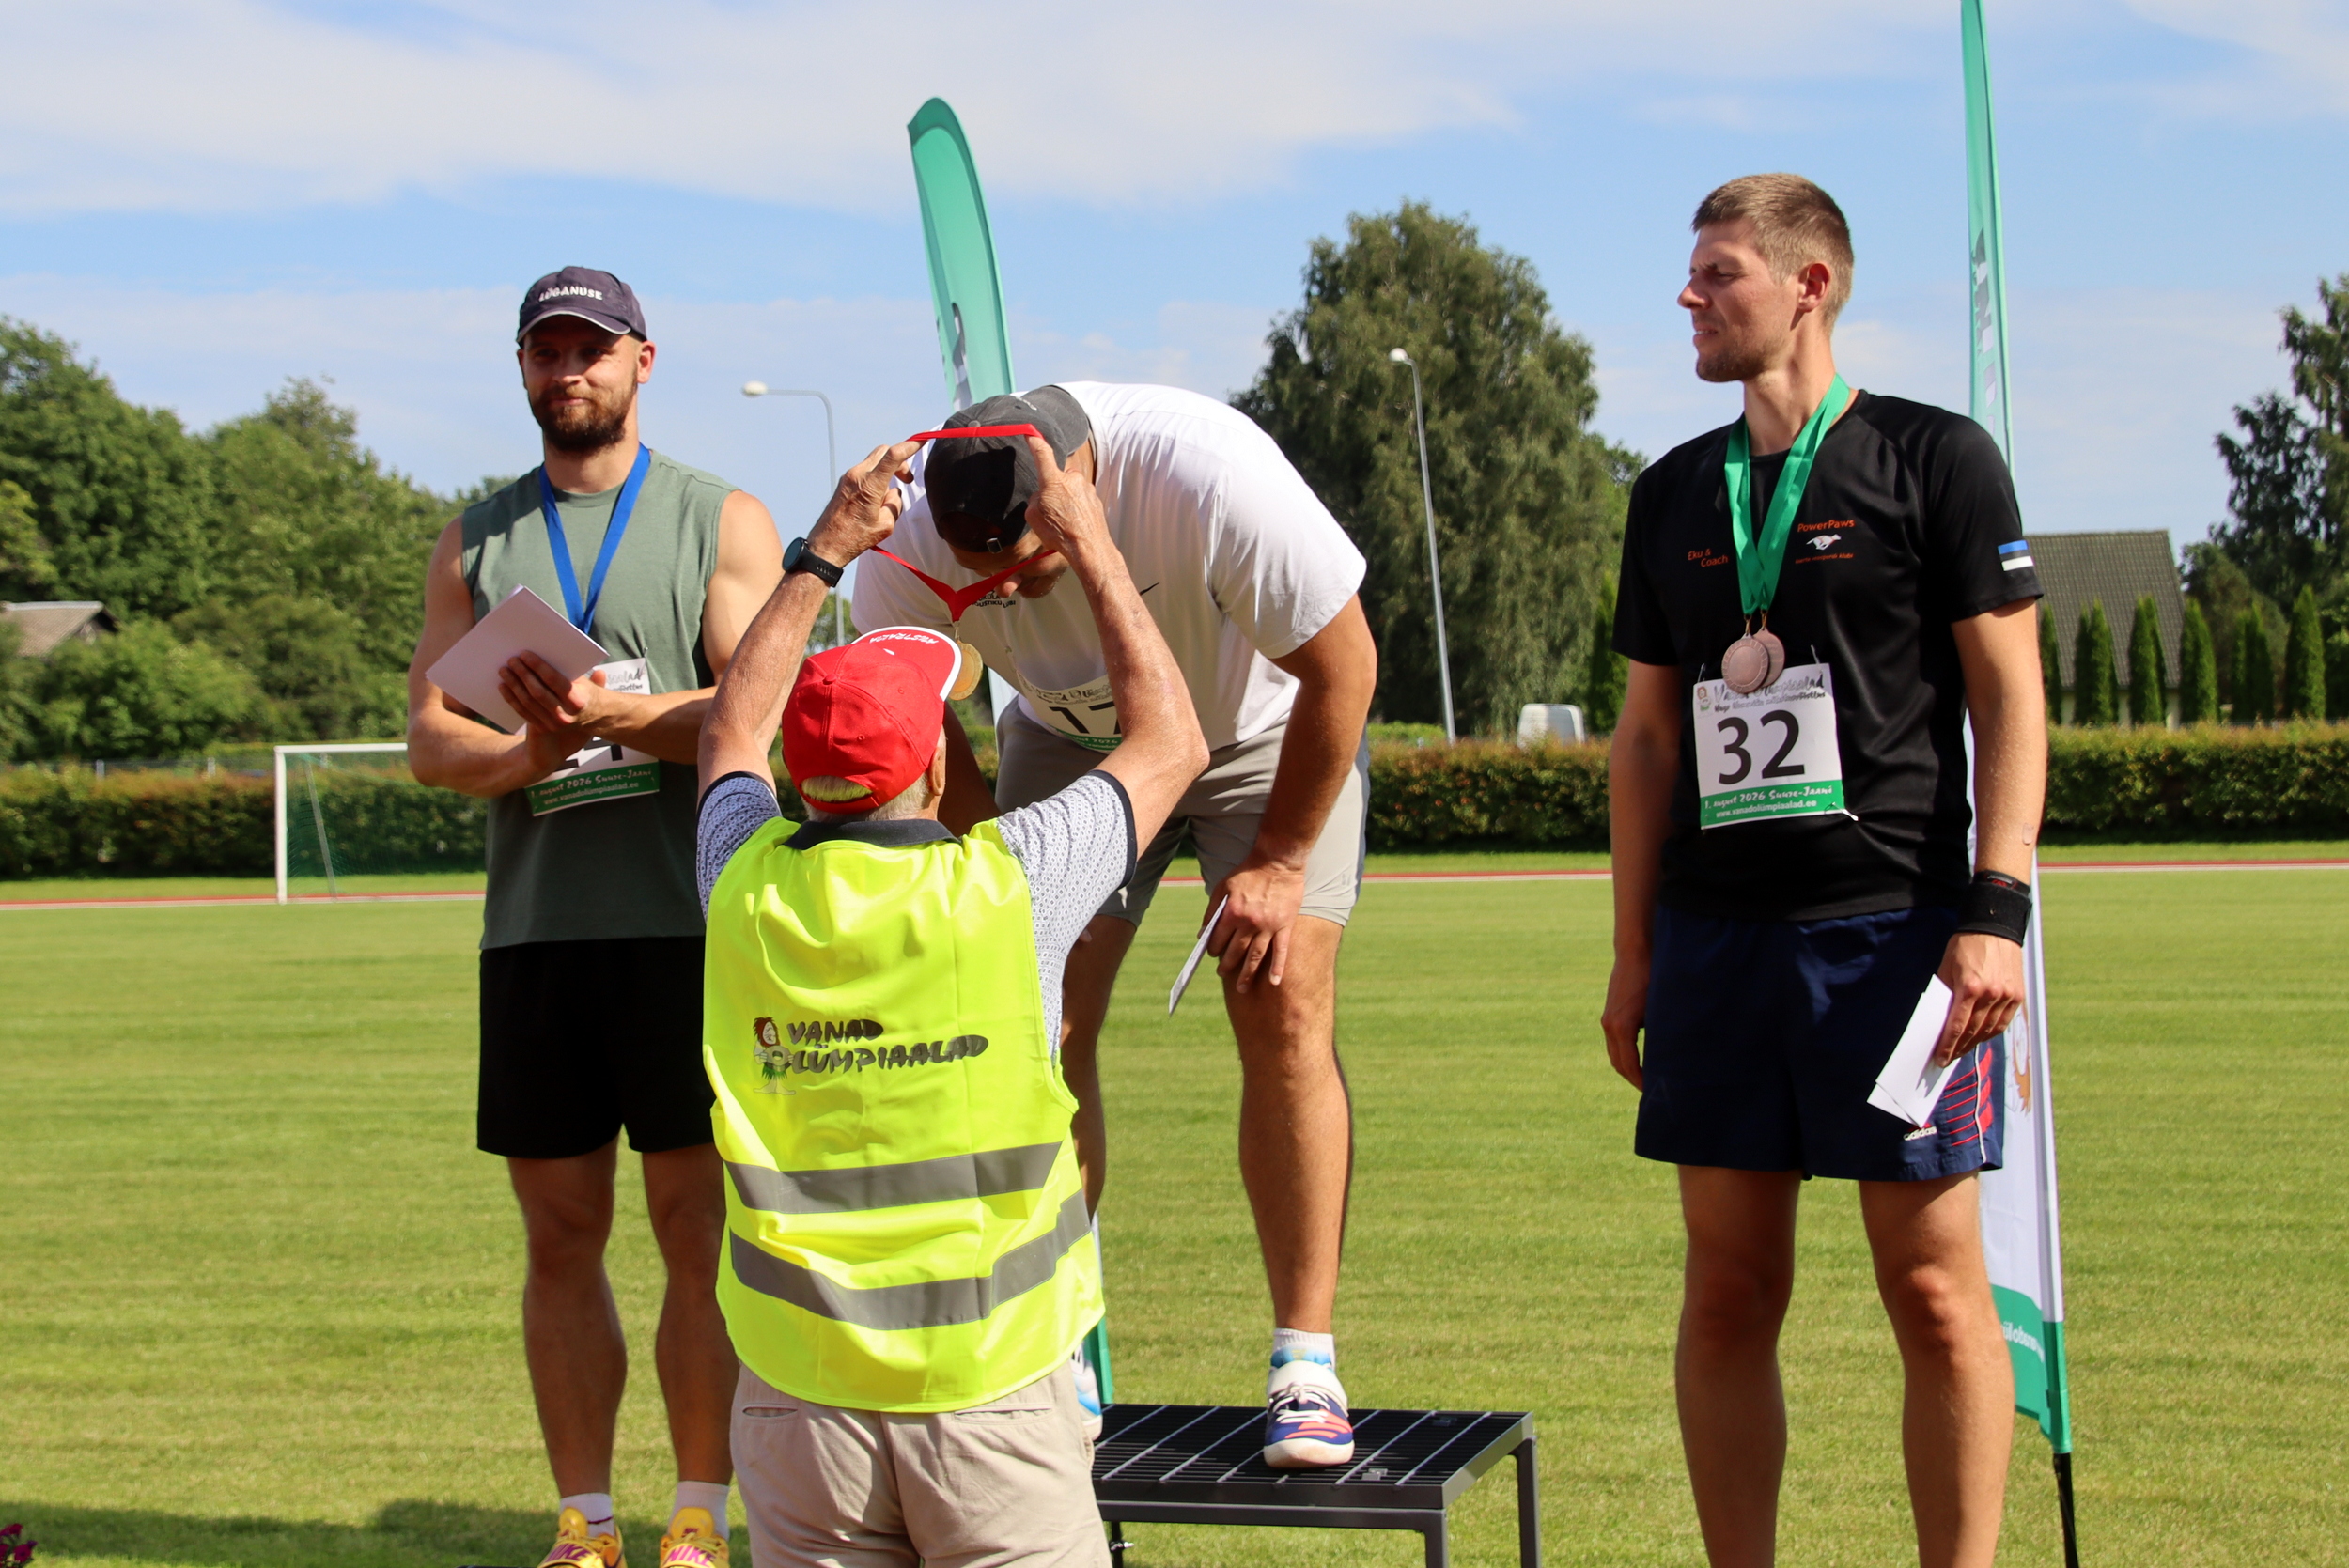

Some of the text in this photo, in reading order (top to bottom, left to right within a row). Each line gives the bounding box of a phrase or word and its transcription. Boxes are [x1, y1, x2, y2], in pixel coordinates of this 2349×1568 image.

[1797, 520, 1855, 533] PowerPaws
[1701, 554, 1728, 567] Coach
[1717, 709, 1805, 785] 32
[567, 777, 592, 789] 2026
[1713, 796, 1737, 809] august
[1739, 791, 1766, 803] 2026
[1768, 785, 1833, 800] Suure-Jaani
[1716, 800, 1817, 818] www.vanadolümpiaalad.ee
[787, 1019, 884, 1045] VANAD
[1903, 1126, 1937, 1141] adidas
[545, 1543, 594, 1563] NIKE
[663, 1545, 717, 1567] NIKE
